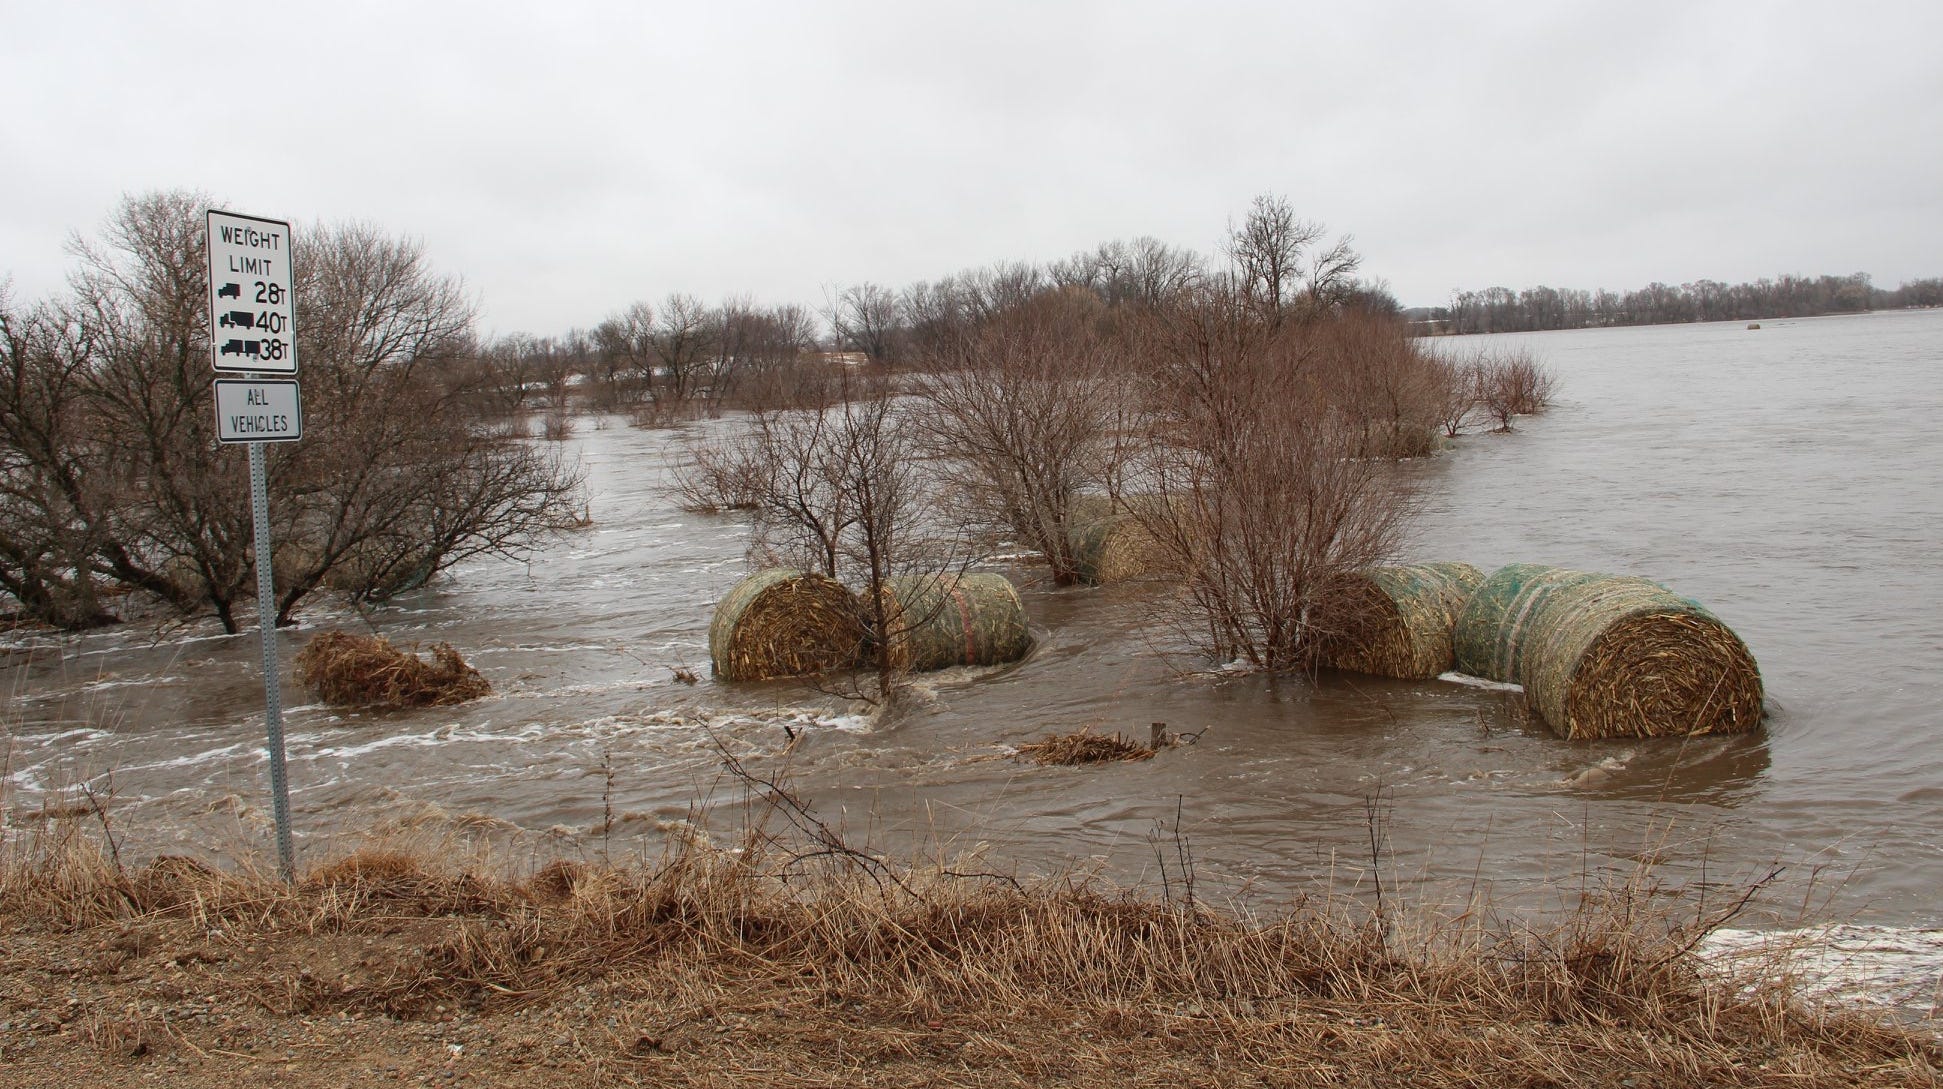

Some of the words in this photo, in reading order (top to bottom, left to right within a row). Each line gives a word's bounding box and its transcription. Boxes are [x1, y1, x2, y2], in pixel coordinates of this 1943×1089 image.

[221, 225, 280, 250] WEIGHT
[229, 255, 272, 276] LIMIT
[254, 281, 286, 305] 28T
[256, 311, 287, 334] 40T
[260, 338, 289, 360] 38T
[247, 389, 269, 406] ALL
[231, 415, 288, 433] VEHICLES
